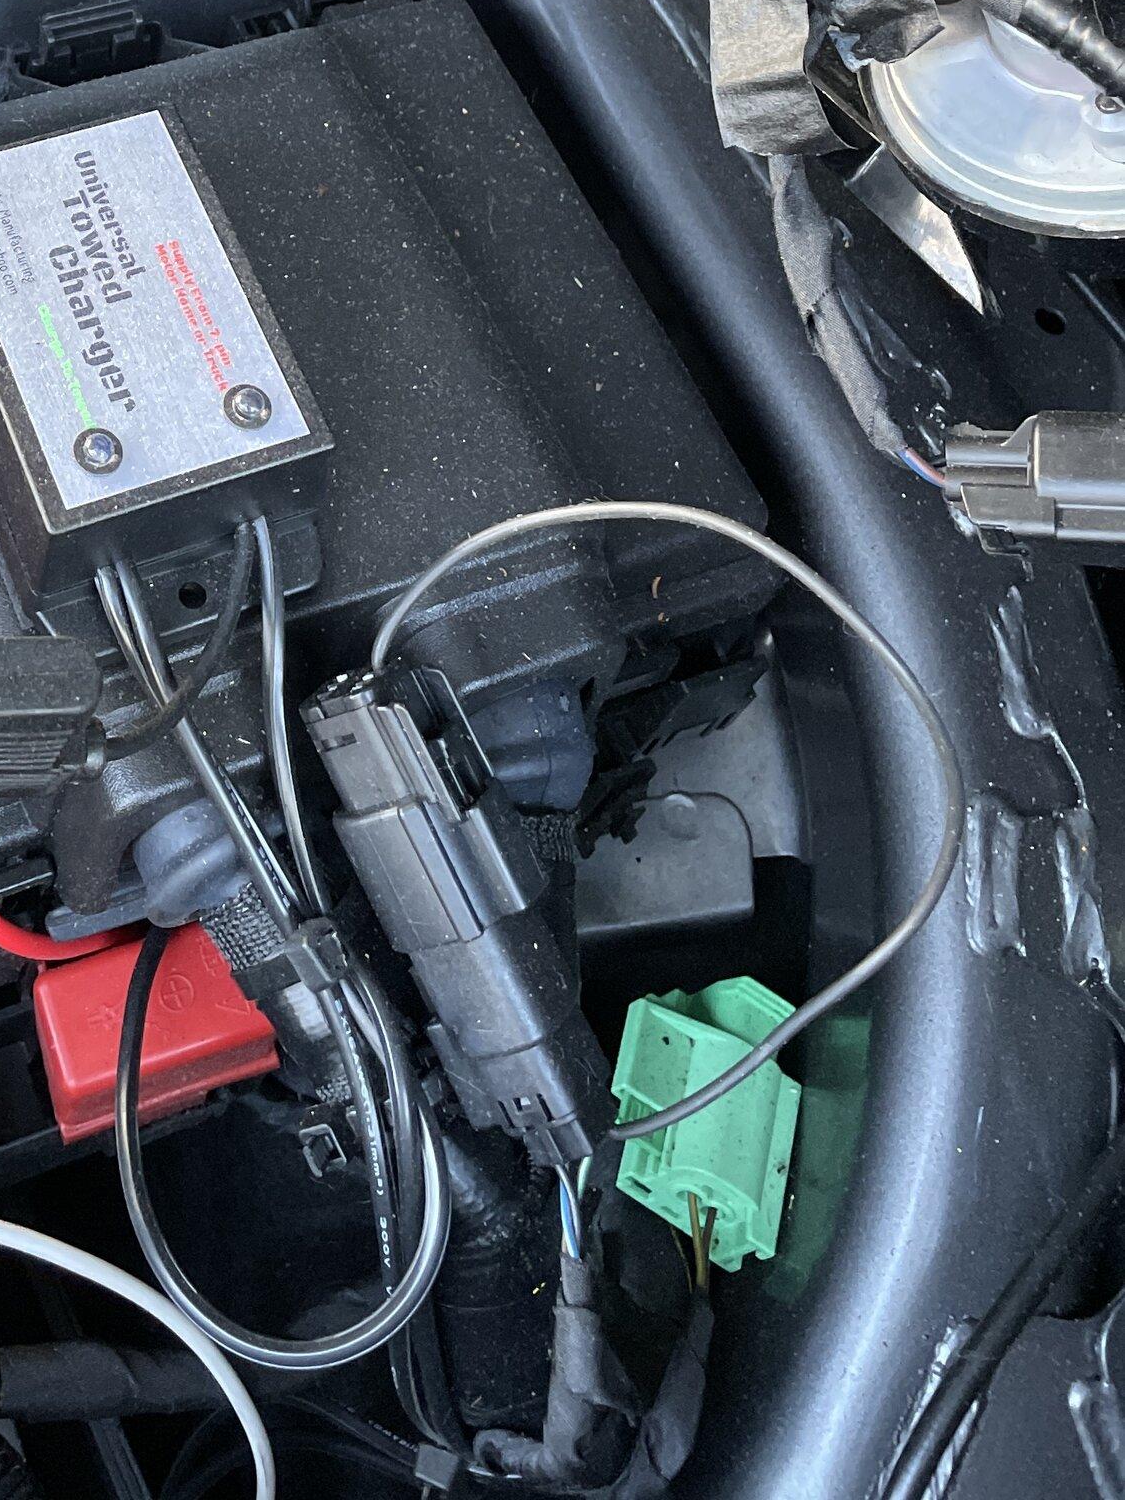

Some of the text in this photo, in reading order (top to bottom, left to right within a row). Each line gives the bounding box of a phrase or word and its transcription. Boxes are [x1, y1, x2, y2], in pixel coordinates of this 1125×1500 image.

[63, 190, 133, 304] Towed
[73, 149, 146, 280] Universal
[49, 243, 136, 413] Charger
[155, 243, 228, 392] Motor Home or Truck
[168, 240, 195, 286] Supply
[191, 286, 213, 326] From
